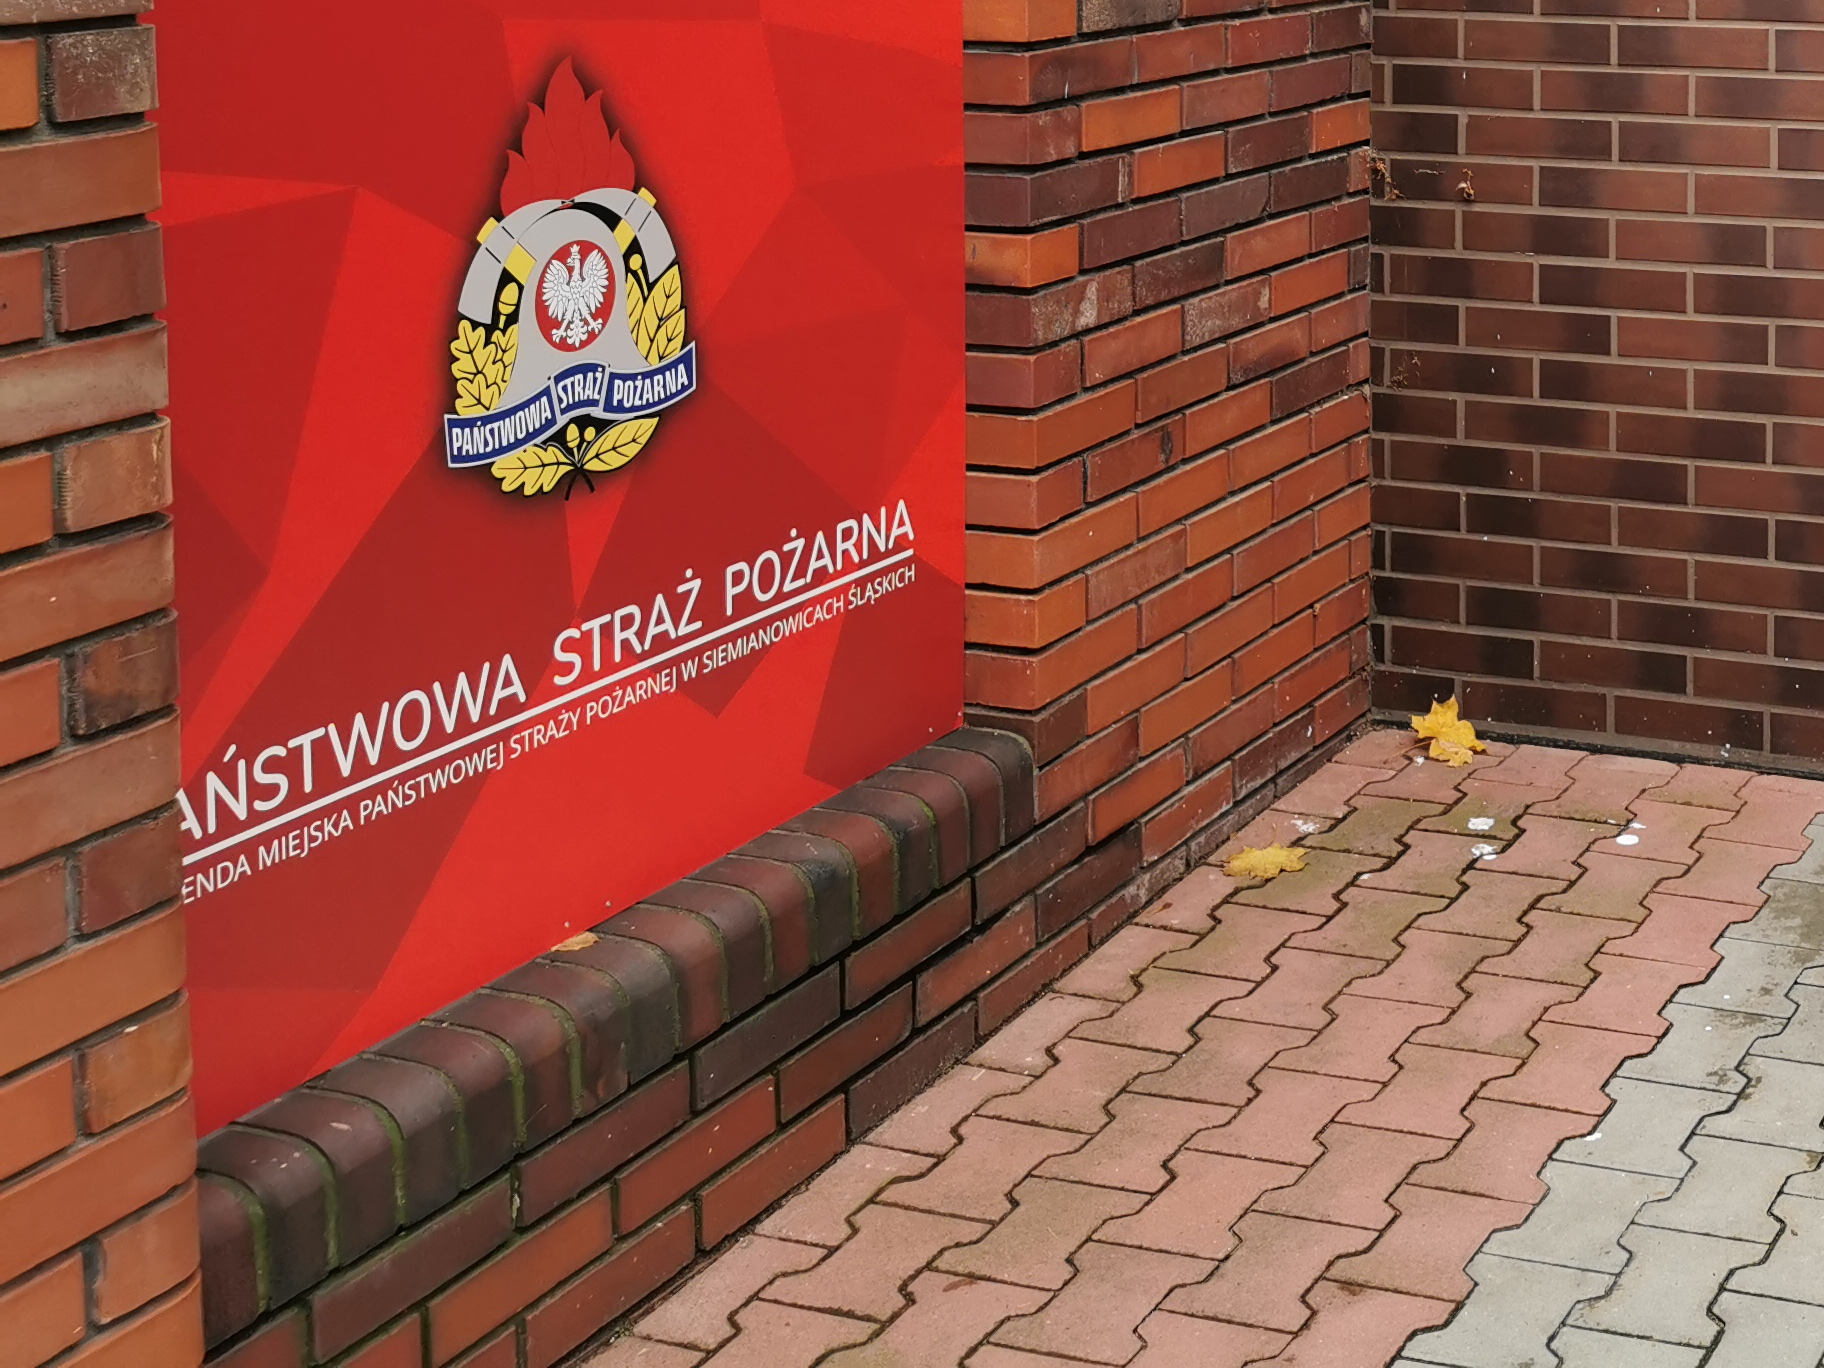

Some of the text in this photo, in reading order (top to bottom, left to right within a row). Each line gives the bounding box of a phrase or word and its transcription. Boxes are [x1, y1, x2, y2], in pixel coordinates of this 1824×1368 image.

[451, 363, 689, 456] PAŃSTWOWA STRAŻ POŻARNA
[175, 499, 915, 839] AŃSTWOWA STRAŻ POŻARNA
[181, 563, 916, 904] ENDA MIEJSKA PAŃSTWOWEJ STRAŻY POŻARNEJ W SIEMIANOWICACH ŚLĄSKICH
